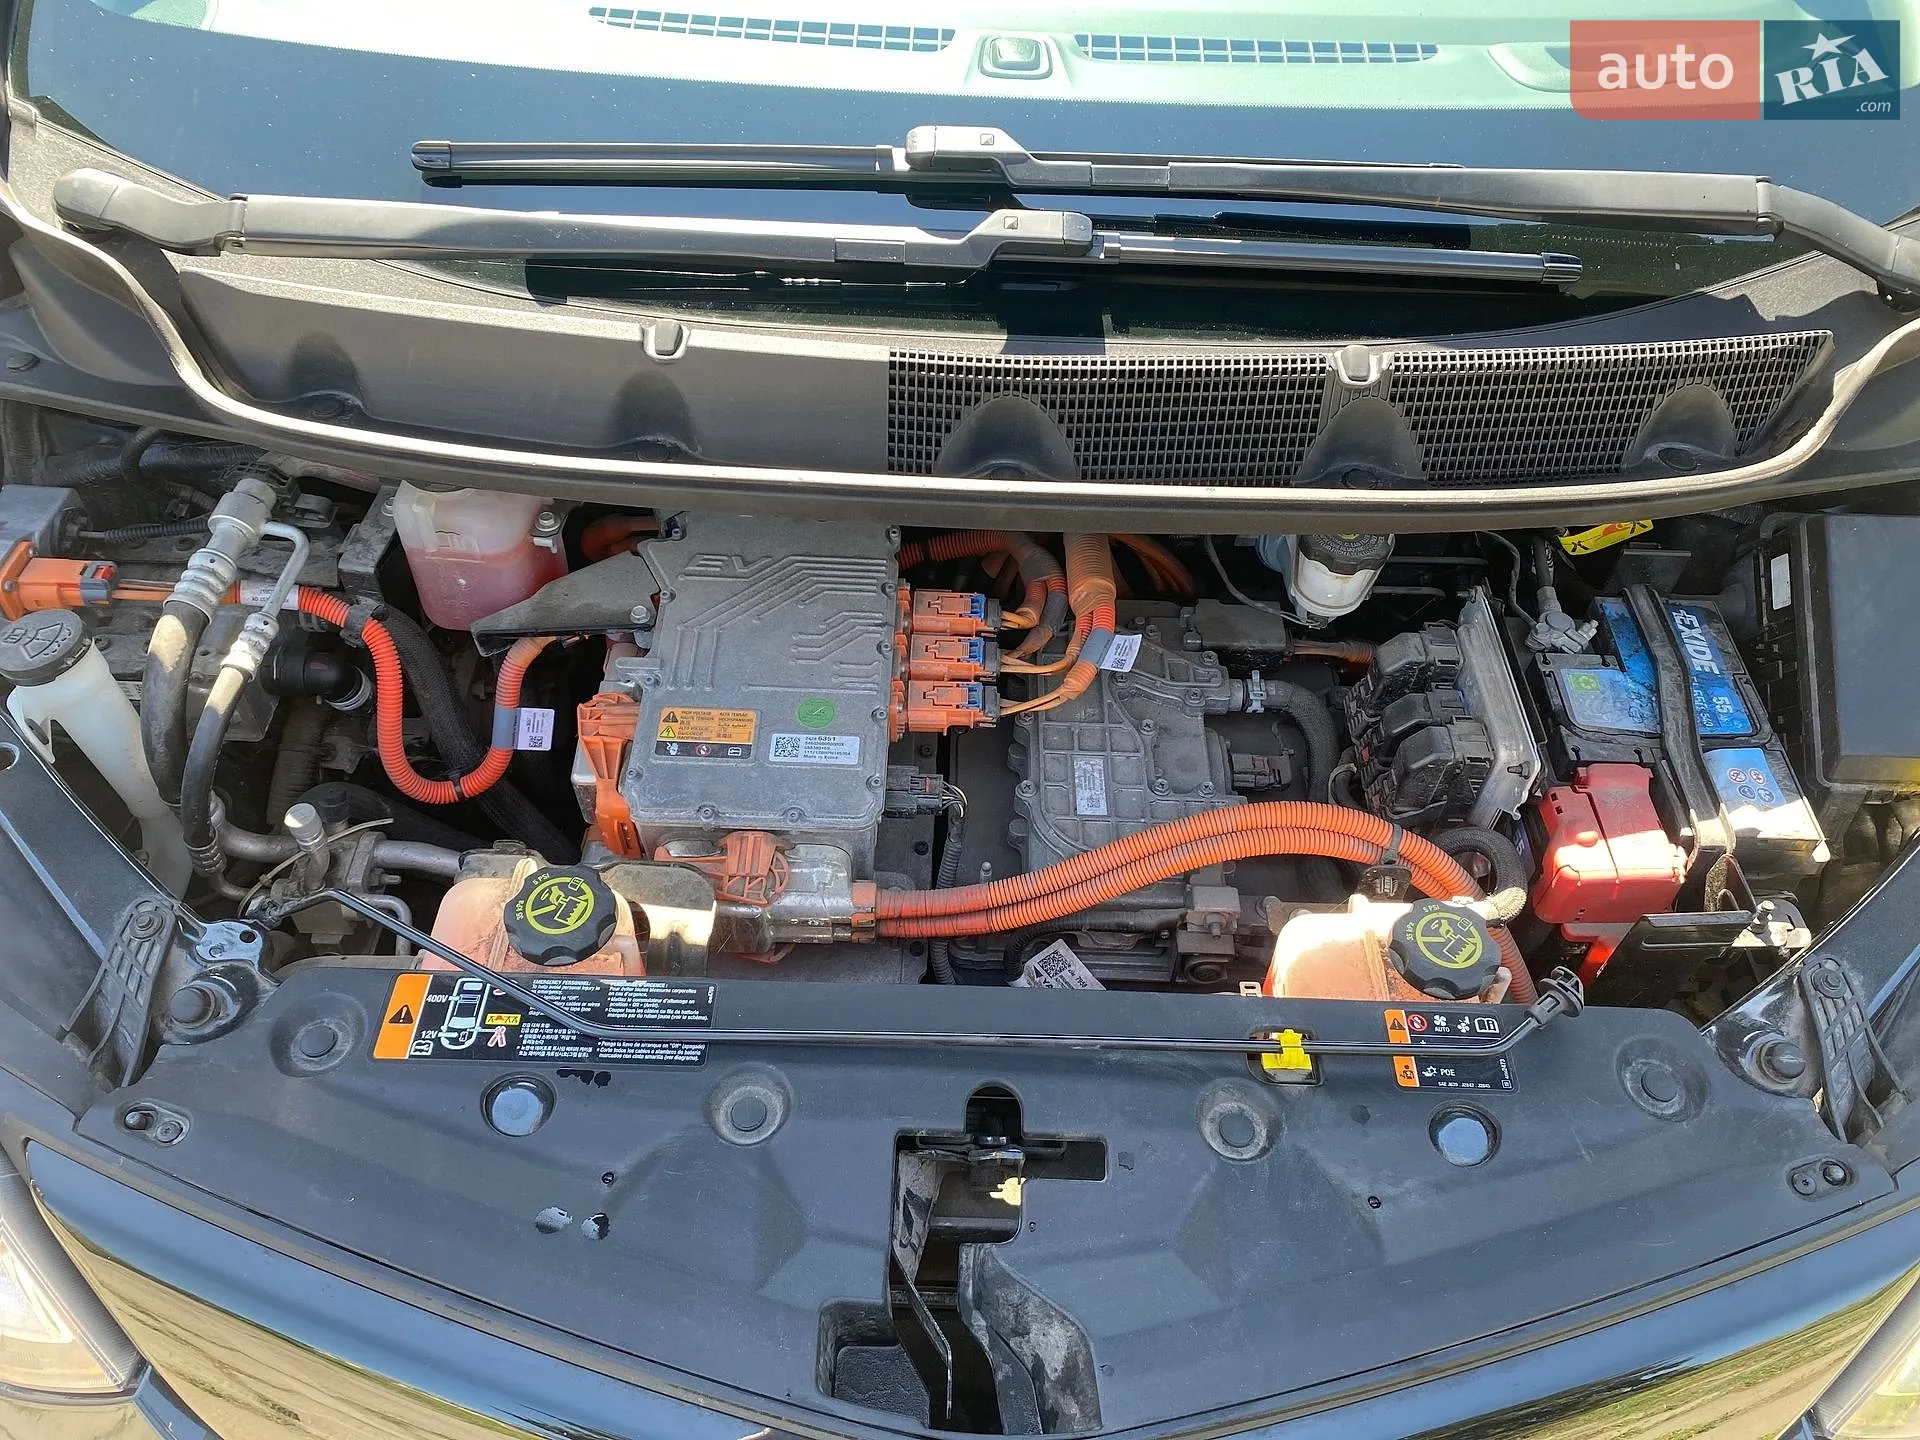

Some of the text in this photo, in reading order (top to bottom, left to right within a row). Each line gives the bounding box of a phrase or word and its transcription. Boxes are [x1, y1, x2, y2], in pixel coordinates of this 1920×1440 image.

[1672, 609, 1720, 675] EXIDE
[1712, 696, 1733, 713] 55
[538, 872, 550, 882] PSI
[1428, 904, 1441, 912] PSI
[426, 994, 449, 1003] 400V
[421, 1030, 439, 1039] 12V
[1440, 1068, 1456, 1077] POE
